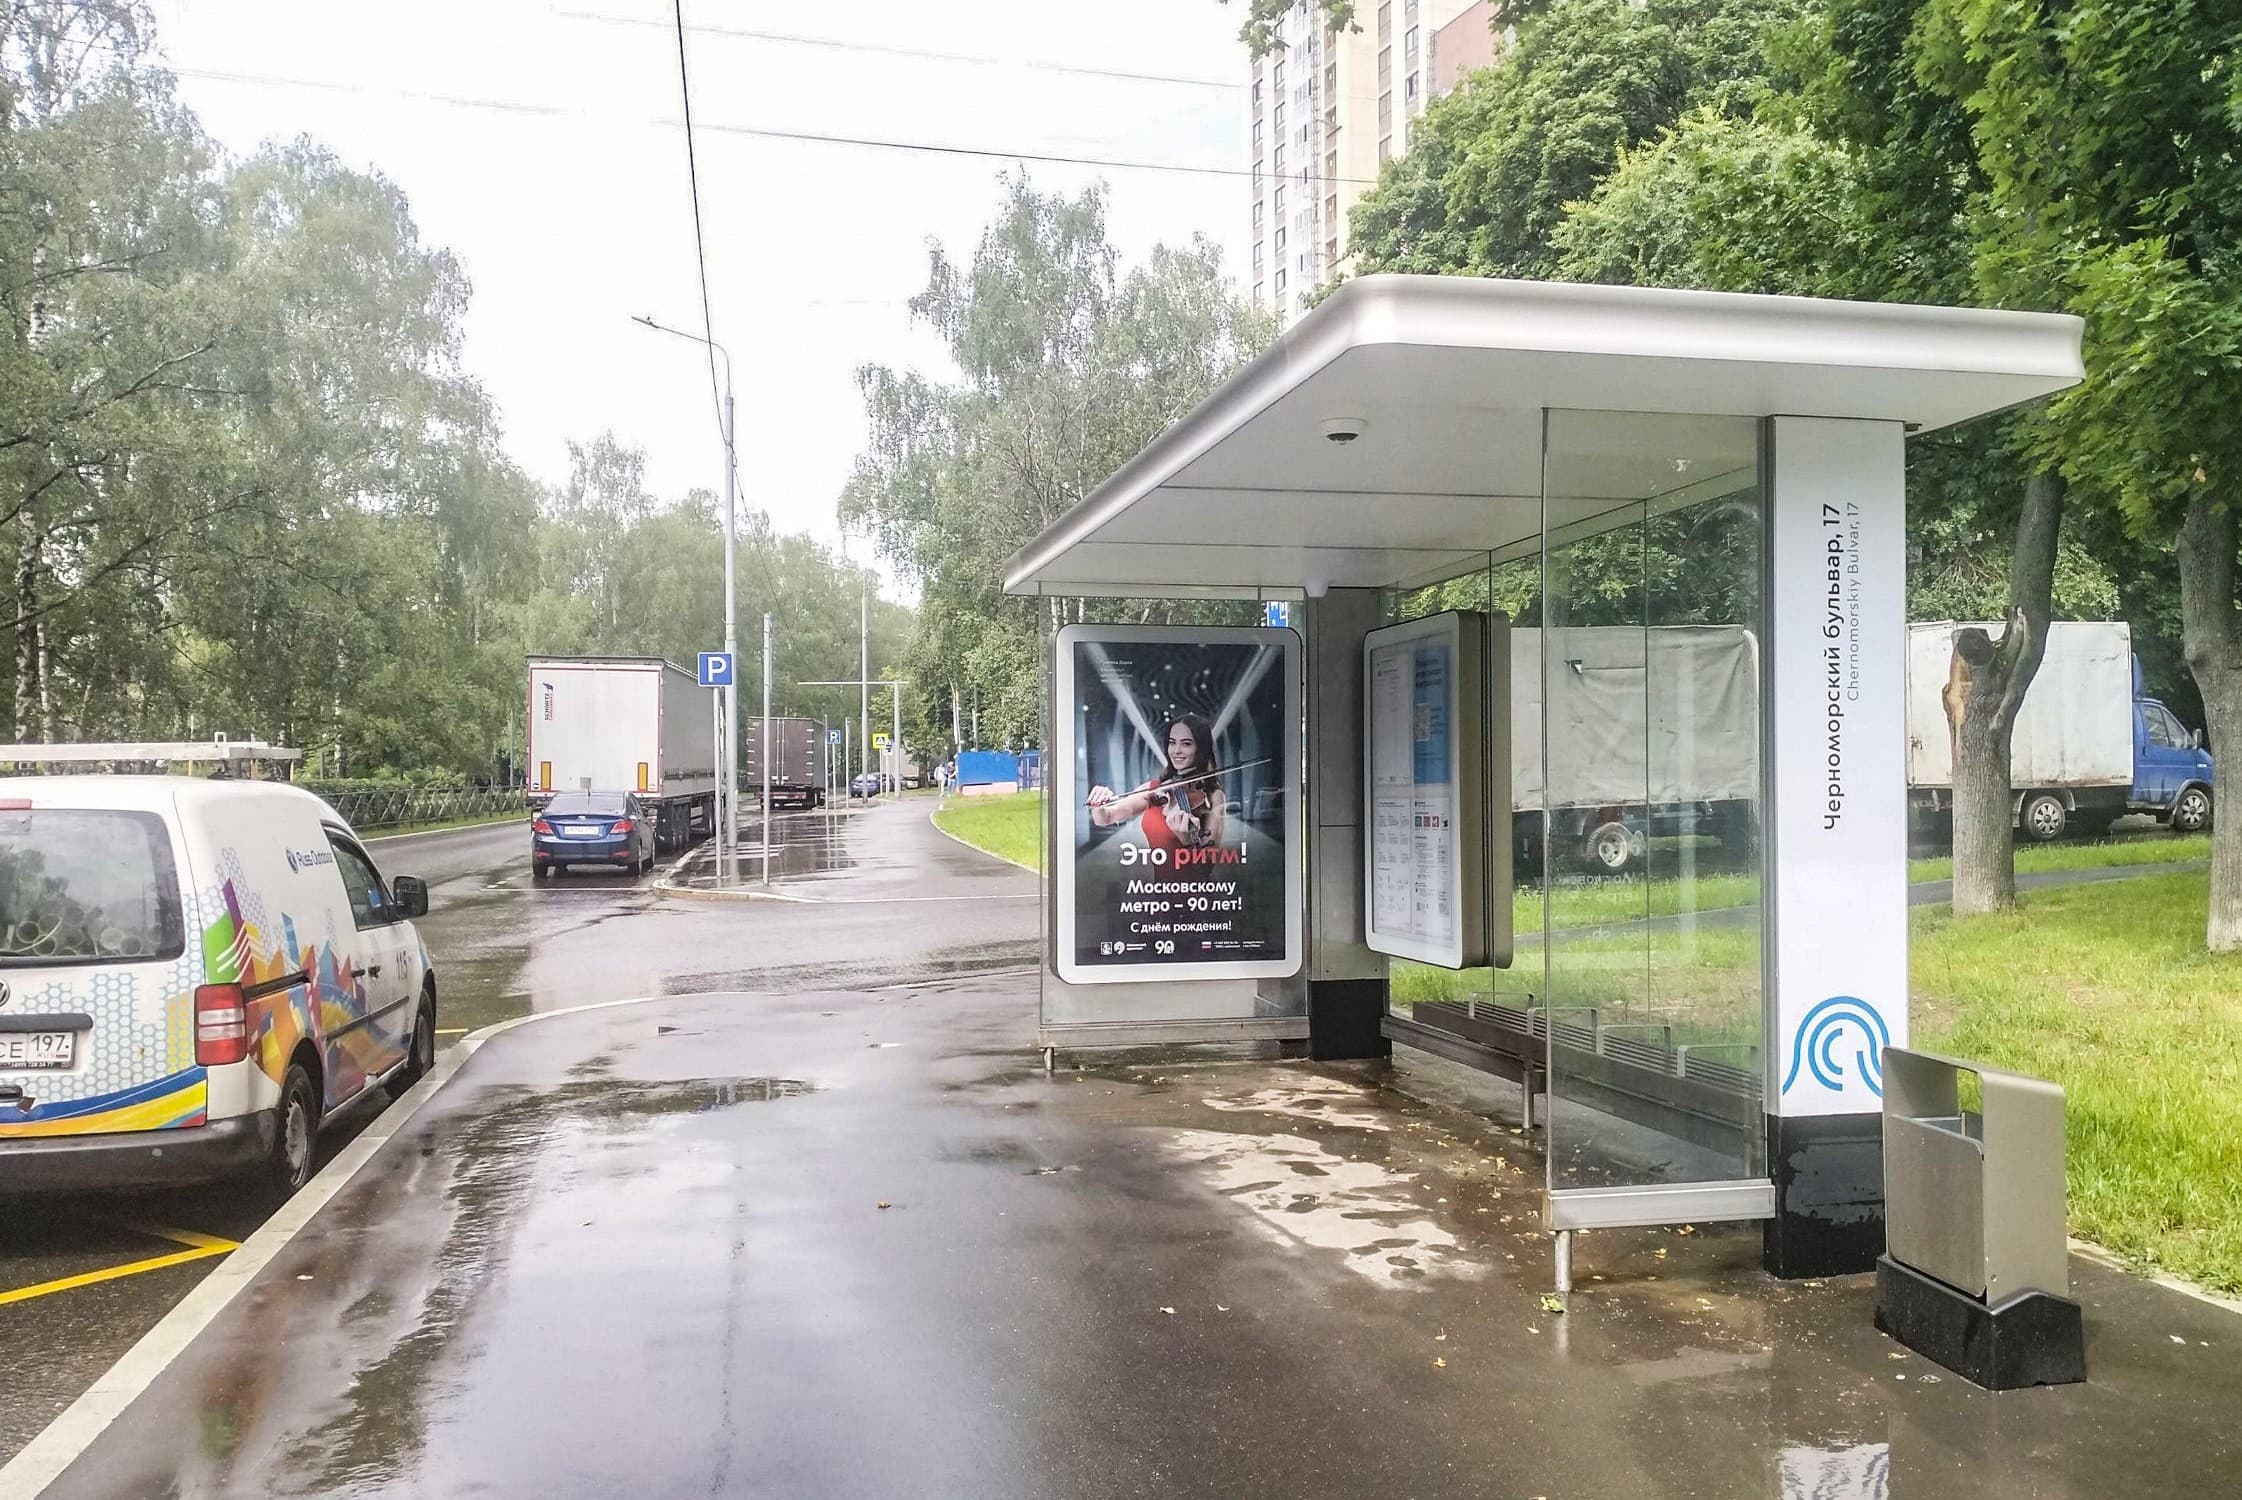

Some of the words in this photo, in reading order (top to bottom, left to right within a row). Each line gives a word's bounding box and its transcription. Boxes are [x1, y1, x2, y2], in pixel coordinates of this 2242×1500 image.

[1822, 503, 1841, 527] 17
[1846, 501, 1860, 517] 17
[1846, 520, 1861, 574] Bulvar,
[1822, 533, 1845, 639] бульвар,
[1846, 578, 1862, 702] Chernomorskiy
[707, 656, 728, 683] P
[830, 731, 839, 743] P
[1823, 646, 1845, 830] Черноморский
[1119, 842, 1168, 866] Это
[1174, 841, 1248, 871] ритм!
[1126, 879, 1237, 896] Московскому
[1119, 900, 1170, 916] метро
[1187, 896, 1209, 912] 90
[1211, 896, 1243, 912] лет!
[1130, 921, 1140, 933] С
[1140, 921, 1171, 934] днём
[1172, 920, 1233, 934] рождения!
[31, 1034, 66, 1052] 197
